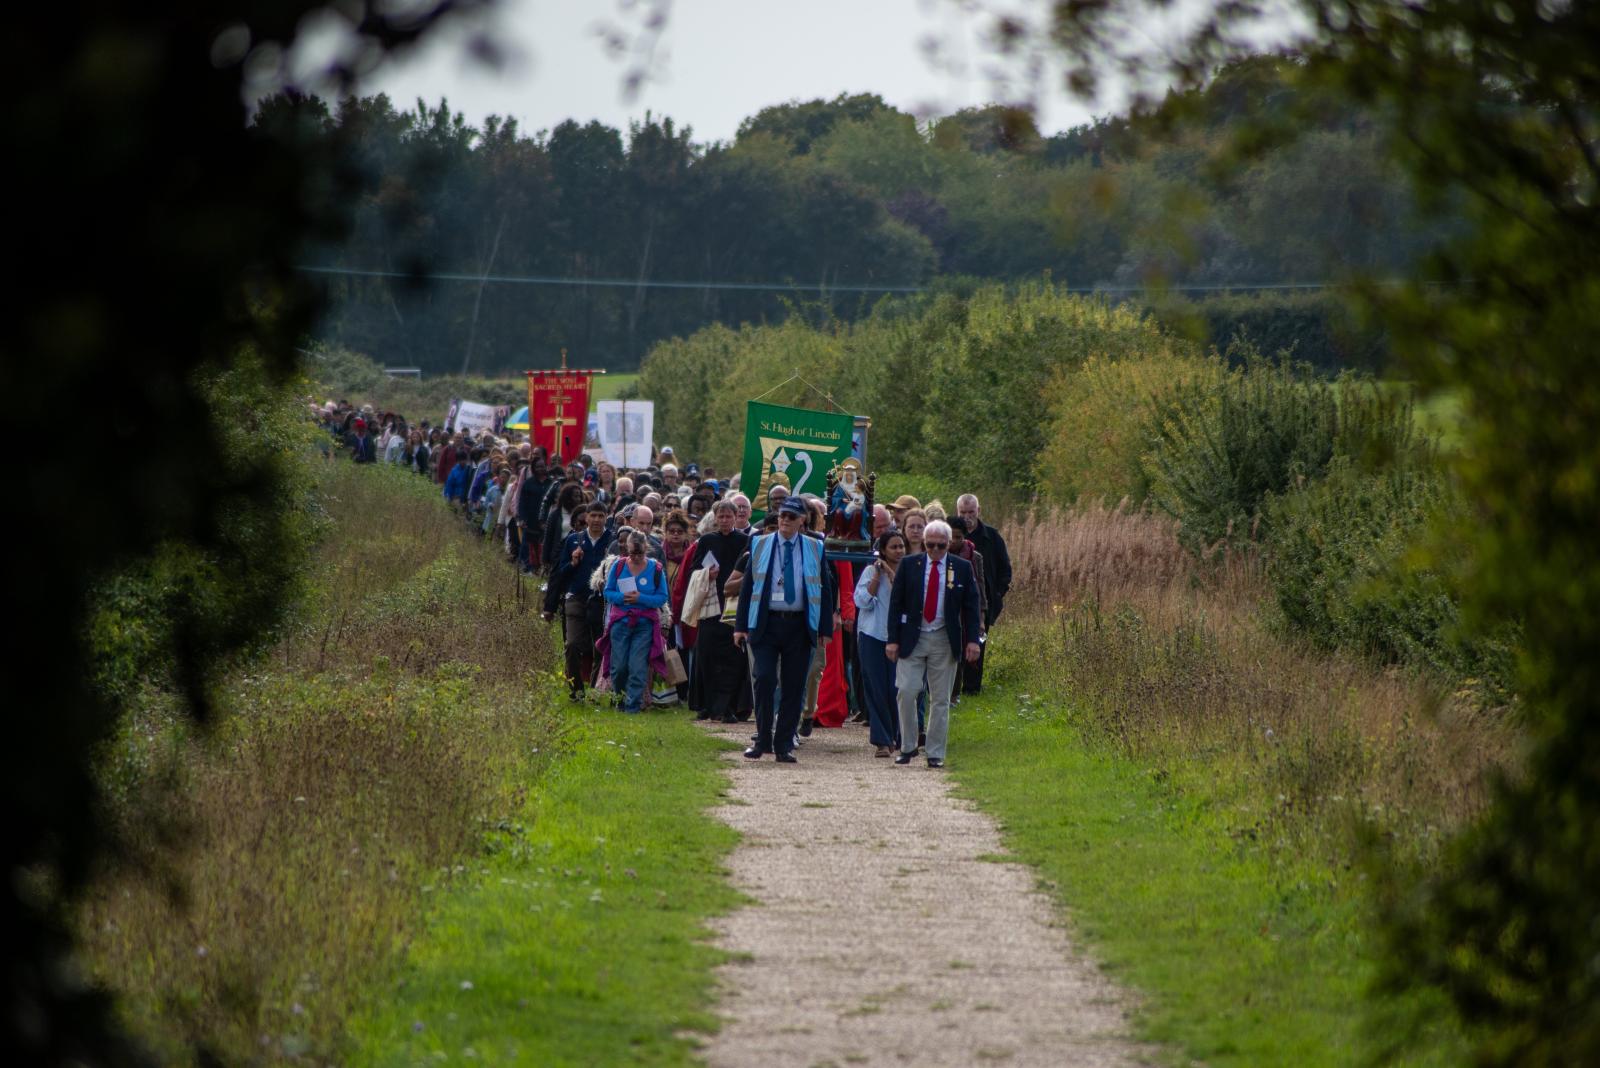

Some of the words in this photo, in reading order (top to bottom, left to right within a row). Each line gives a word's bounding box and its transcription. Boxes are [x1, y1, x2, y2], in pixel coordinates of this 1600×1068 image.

[760, 421, 771, 431] St.
[772, 422, 796, 436] Hugh
[796, 427, 807, 436] of
[809, 427, 841, 440] Lincoln
